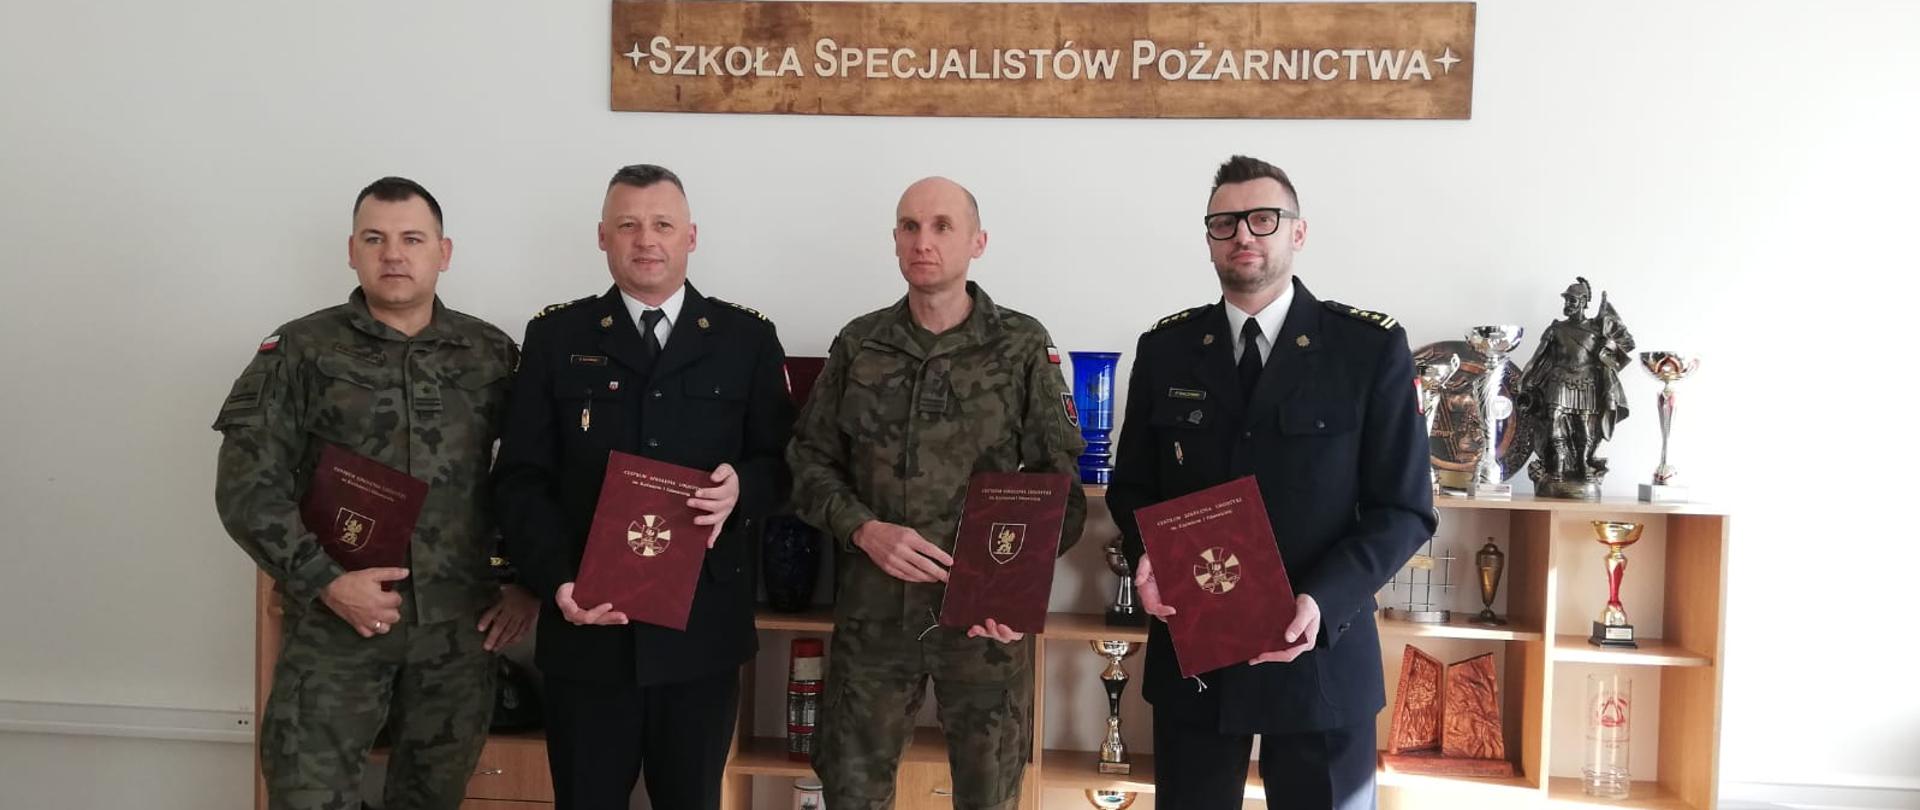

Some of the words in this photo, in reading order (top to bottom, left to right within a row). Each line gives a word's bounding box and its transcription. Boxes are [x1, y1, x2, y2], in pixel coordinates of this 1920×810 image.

[649, 36, 804, 77] SZKOŁA
[814, 38, 1120, 80] SPECJALISTÓW
[1132, 39, 1432, 81] POŻARNICTWA
